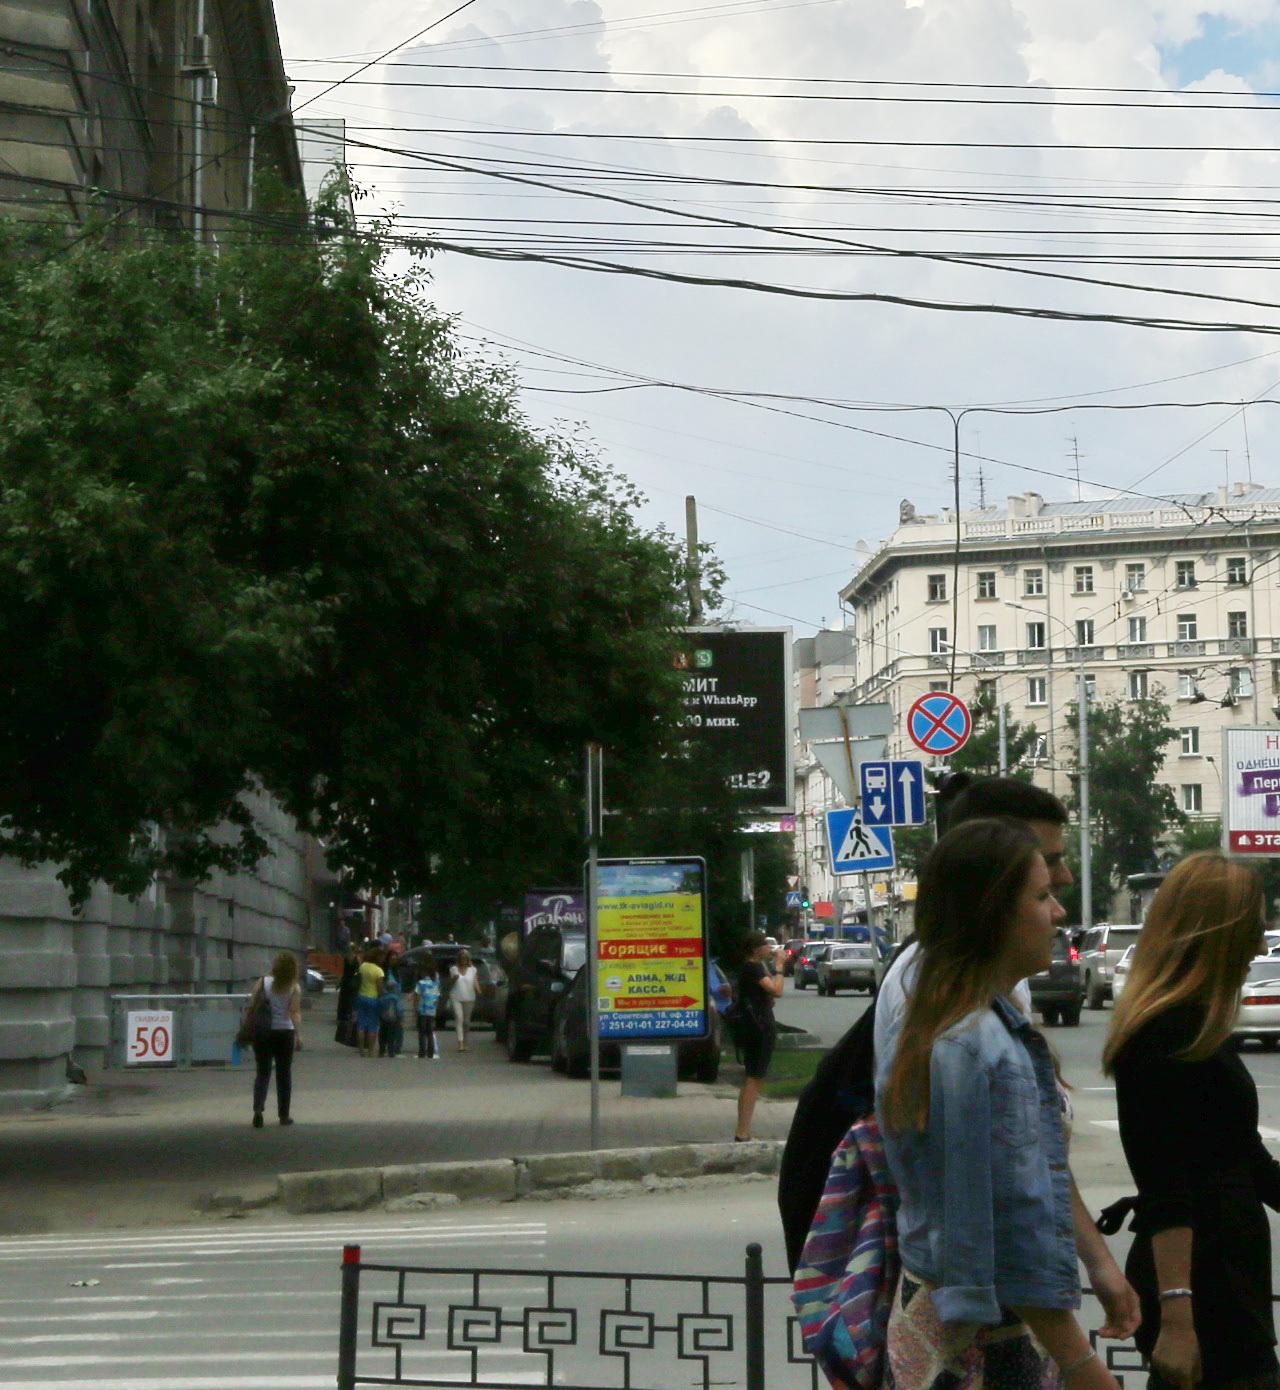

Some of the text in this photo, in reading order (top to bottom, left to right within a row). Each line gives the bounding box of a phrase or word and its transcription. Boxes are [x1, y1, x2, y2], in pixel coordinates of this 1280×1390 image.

[703, 694, 758, 708] WhatsApp
[600, 941, 668, 957] Горящие
[627, 985, 667, 994] КАССА
